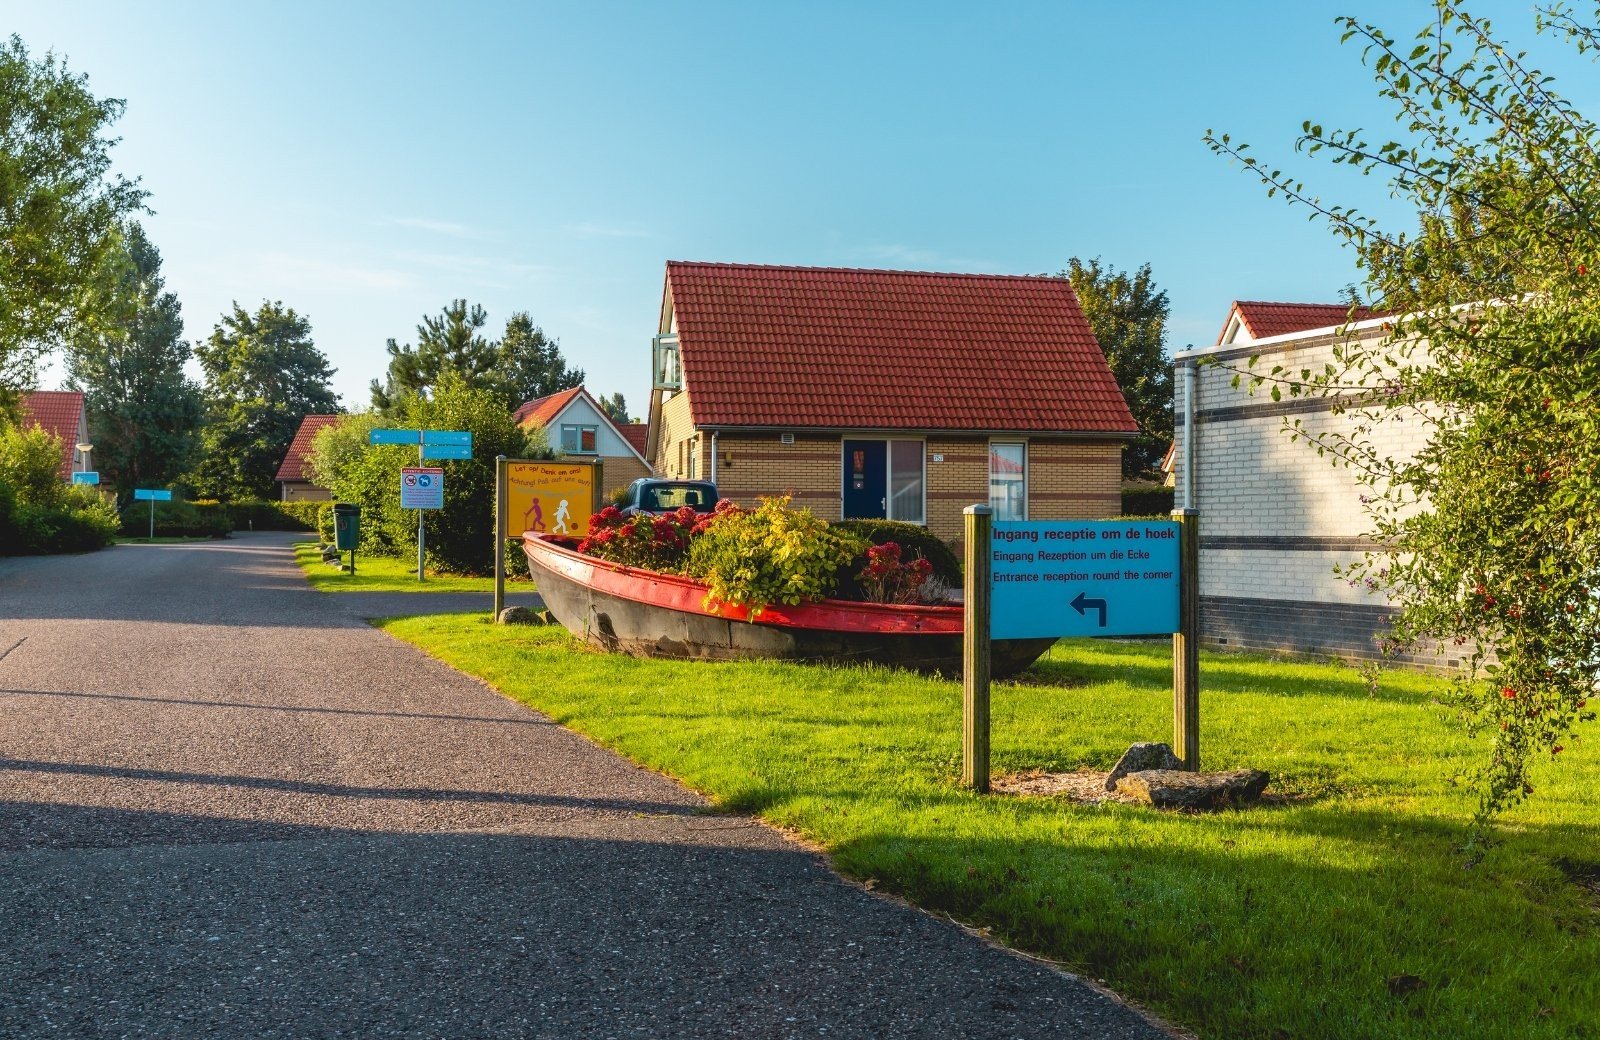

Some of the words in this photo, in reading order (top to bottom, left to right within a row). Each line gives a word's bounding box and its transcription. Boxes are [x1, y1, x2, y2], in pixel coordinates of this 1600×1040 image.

[993, 528, 1038, 542] Ingang
[1044, 528, 1096, 542] receptie
[1102, 530, 1120, 539] om
[1126, 528, 1140, 539] de
[1146, 528, 1175, 539] hoek
[993, 551, 1034, 562] Eingang
[1038, 551, 1087, 562] Rezeption
[1110, 550, 1124, 559] die
[1128, 550, 1150, 559] Ecke
[993, 572, 1038, 582] Entrance
[1043, 571, 1088, 582] reception
[1093, 570, 1120, 580] round
[1124, 570, 1139, 579] the
[1143, 571, 1172, 579] corner
